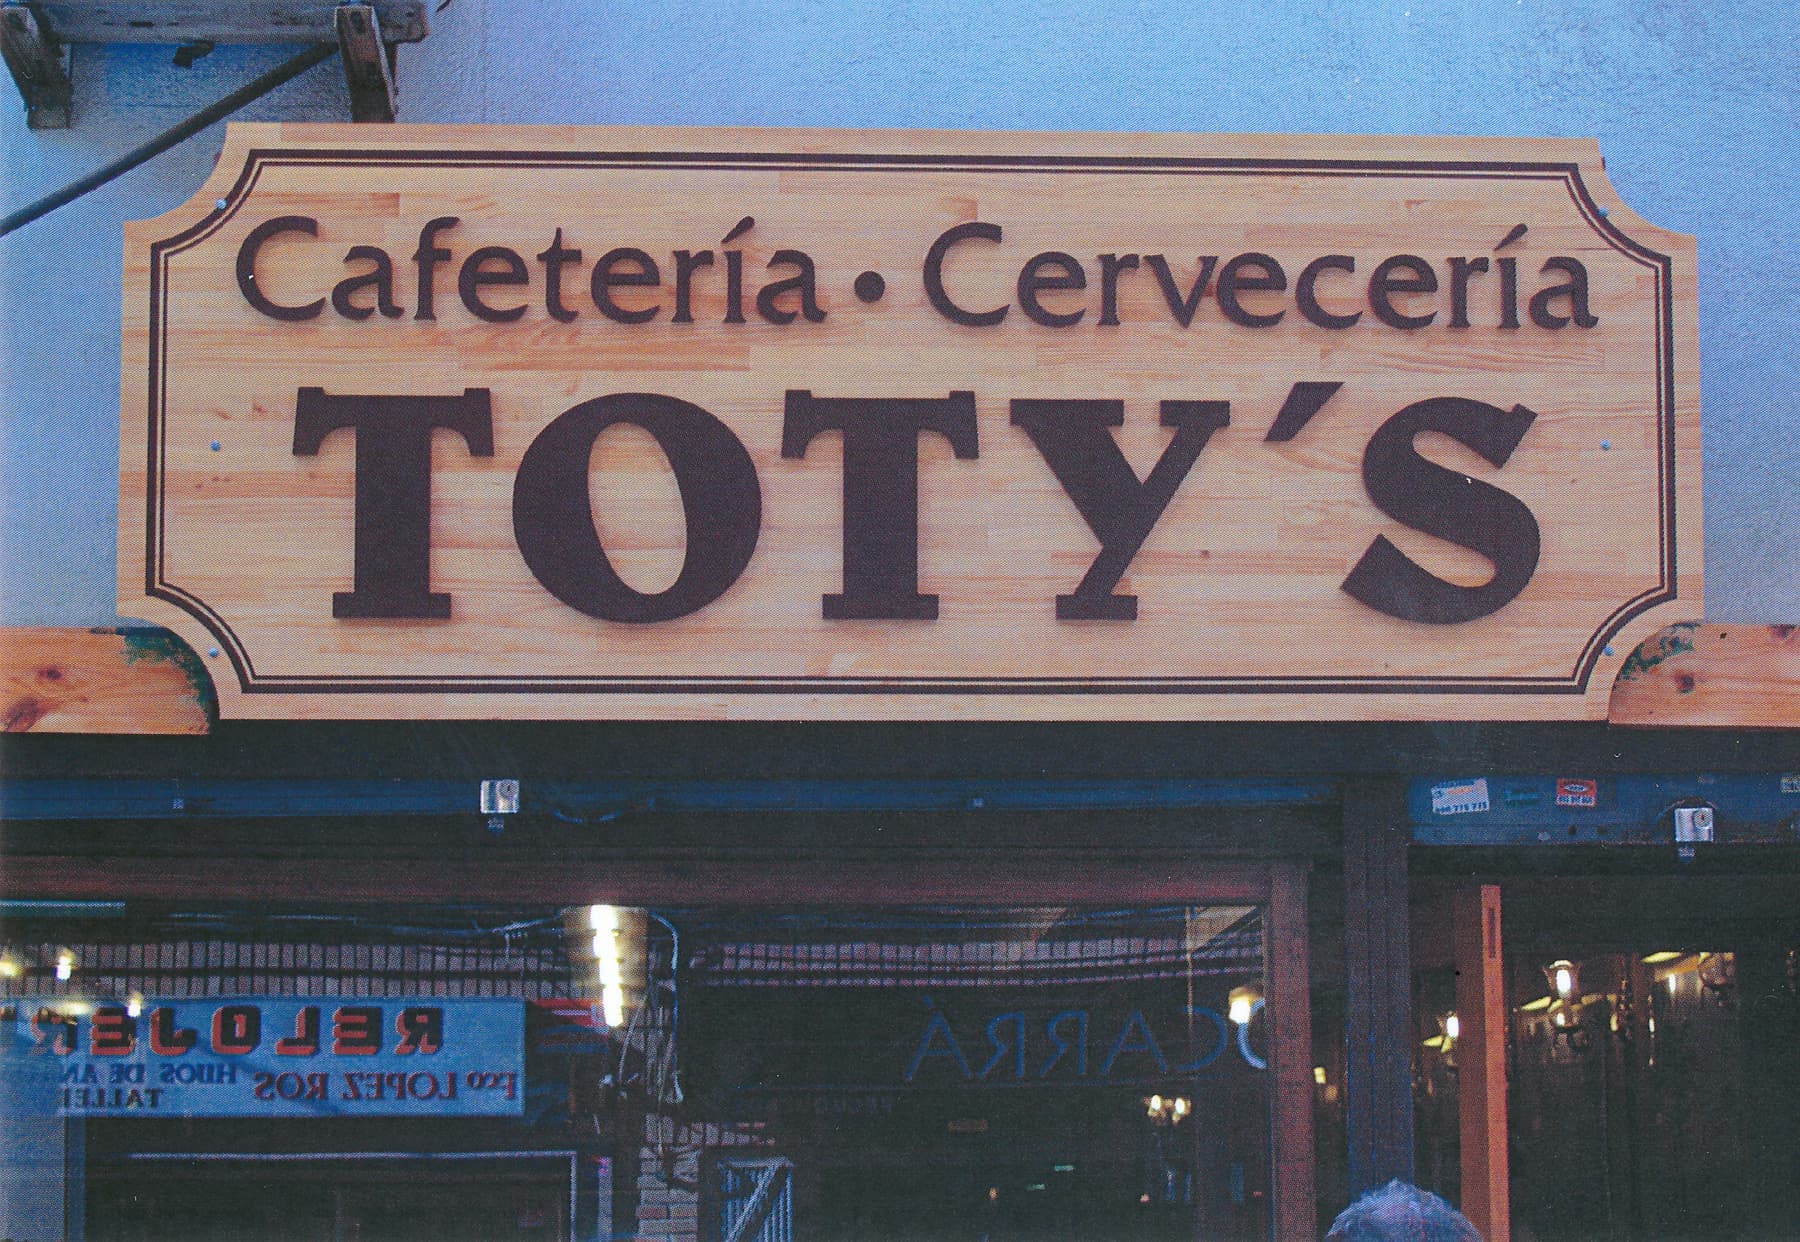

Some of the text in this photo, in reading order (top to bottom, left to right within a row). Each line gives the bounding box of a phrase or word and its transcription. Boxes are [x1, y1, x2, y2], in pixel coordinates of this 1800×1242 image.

[236, 214, 1600, 330] Cafetería Cervecería
[292, 380, 1541, 625] TOTY'S
